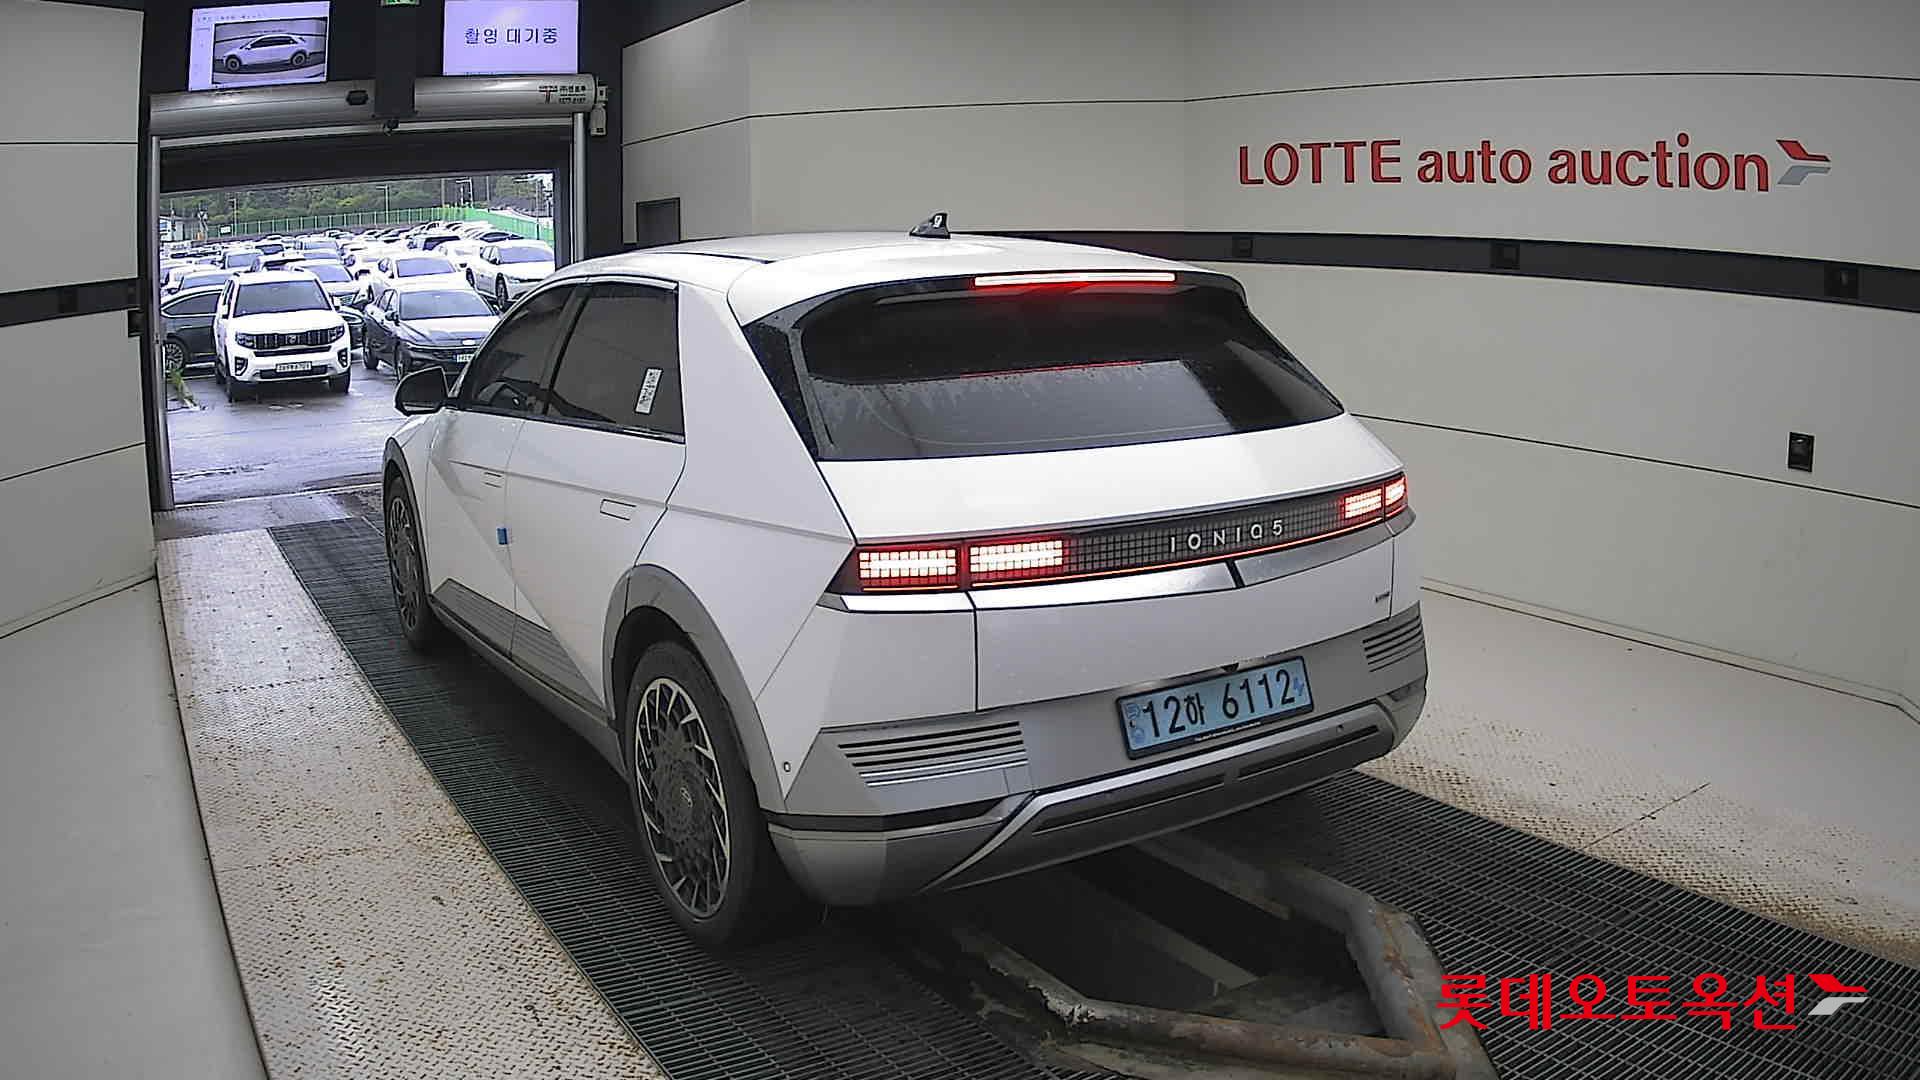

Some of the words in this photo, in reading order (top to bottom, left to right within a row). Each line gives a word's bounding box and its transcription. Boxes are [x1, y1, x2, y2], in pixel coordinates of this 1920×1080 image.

[506, 27, 558, 45] 대기중
[1239, 139, 1401, 185] LOTTE
[1417, 139, 1532, 184] auto
[1548, 132, 1770, 192] auction
[1142, 691, 1205, 738] 12하
[1222, 668, 1296, 719] 6112
